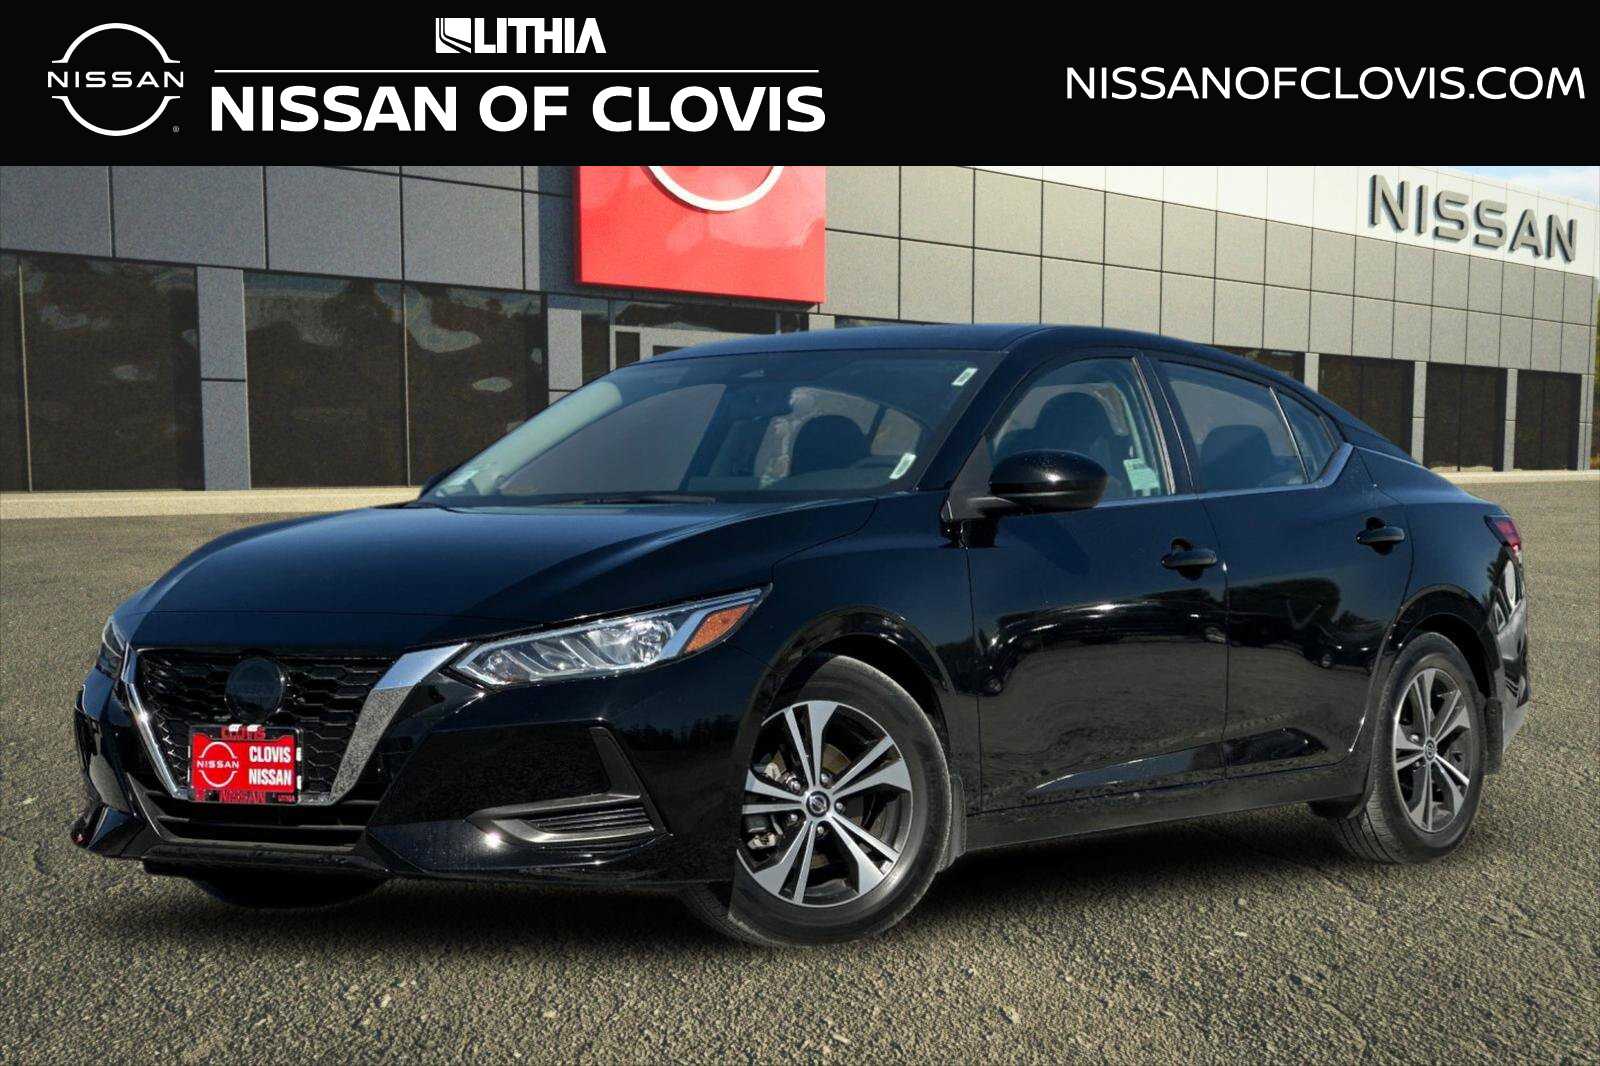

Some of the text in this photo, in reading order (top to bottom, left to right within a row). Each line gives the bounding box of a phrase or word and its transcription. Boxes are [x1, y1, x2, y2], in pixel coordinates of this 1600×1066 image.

[1368, 173, 1578, 264] NISSAN
[249, 745, 291, 763] CLOVIS
[196, 759, 240, 769] NISSAN
[249, 769, 292, 786] NISSAN
